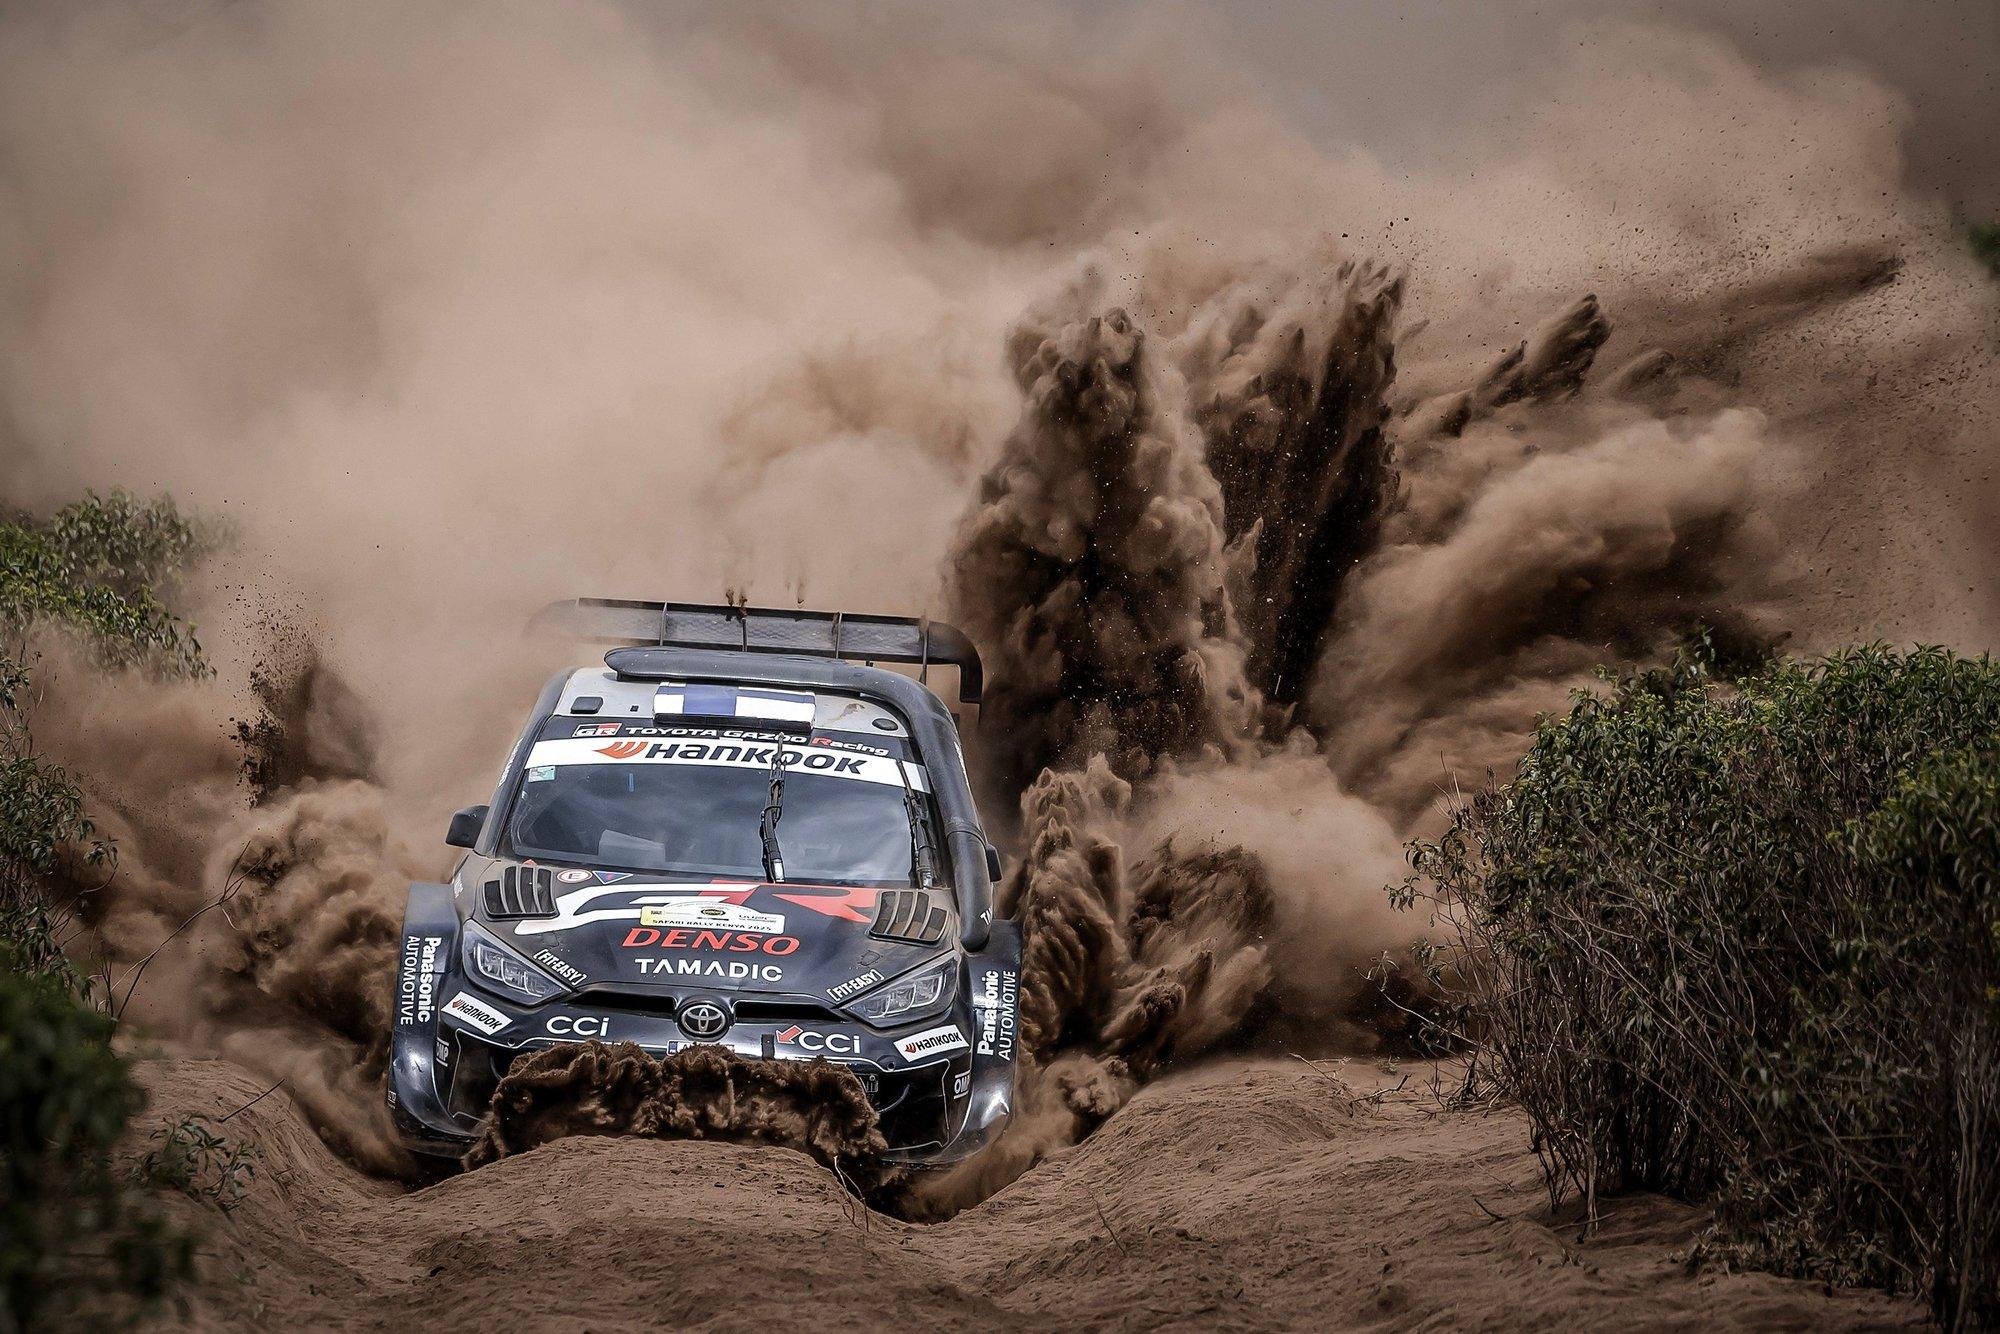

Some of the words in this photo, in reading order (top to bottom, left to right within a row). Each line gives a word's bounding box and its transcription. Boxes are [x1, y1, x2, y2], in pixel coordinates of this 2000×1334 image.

[626, 727, 717, 736] TOYOTA
[723, 730, 808, 743] GAZOO
[811, 736, 890, 756] Racing
[400, 935, 421, 1026] AUTOMOTIVE
[417, 936, 442, 1023] Panasonic
[622, 927, 801, 956] DENSO
[634, 958, 784, 982] TAMADIC
[977, 970, 999, 1055] Panasonic
[998, 970, 1016, 1061] AUTOMOTIVE
